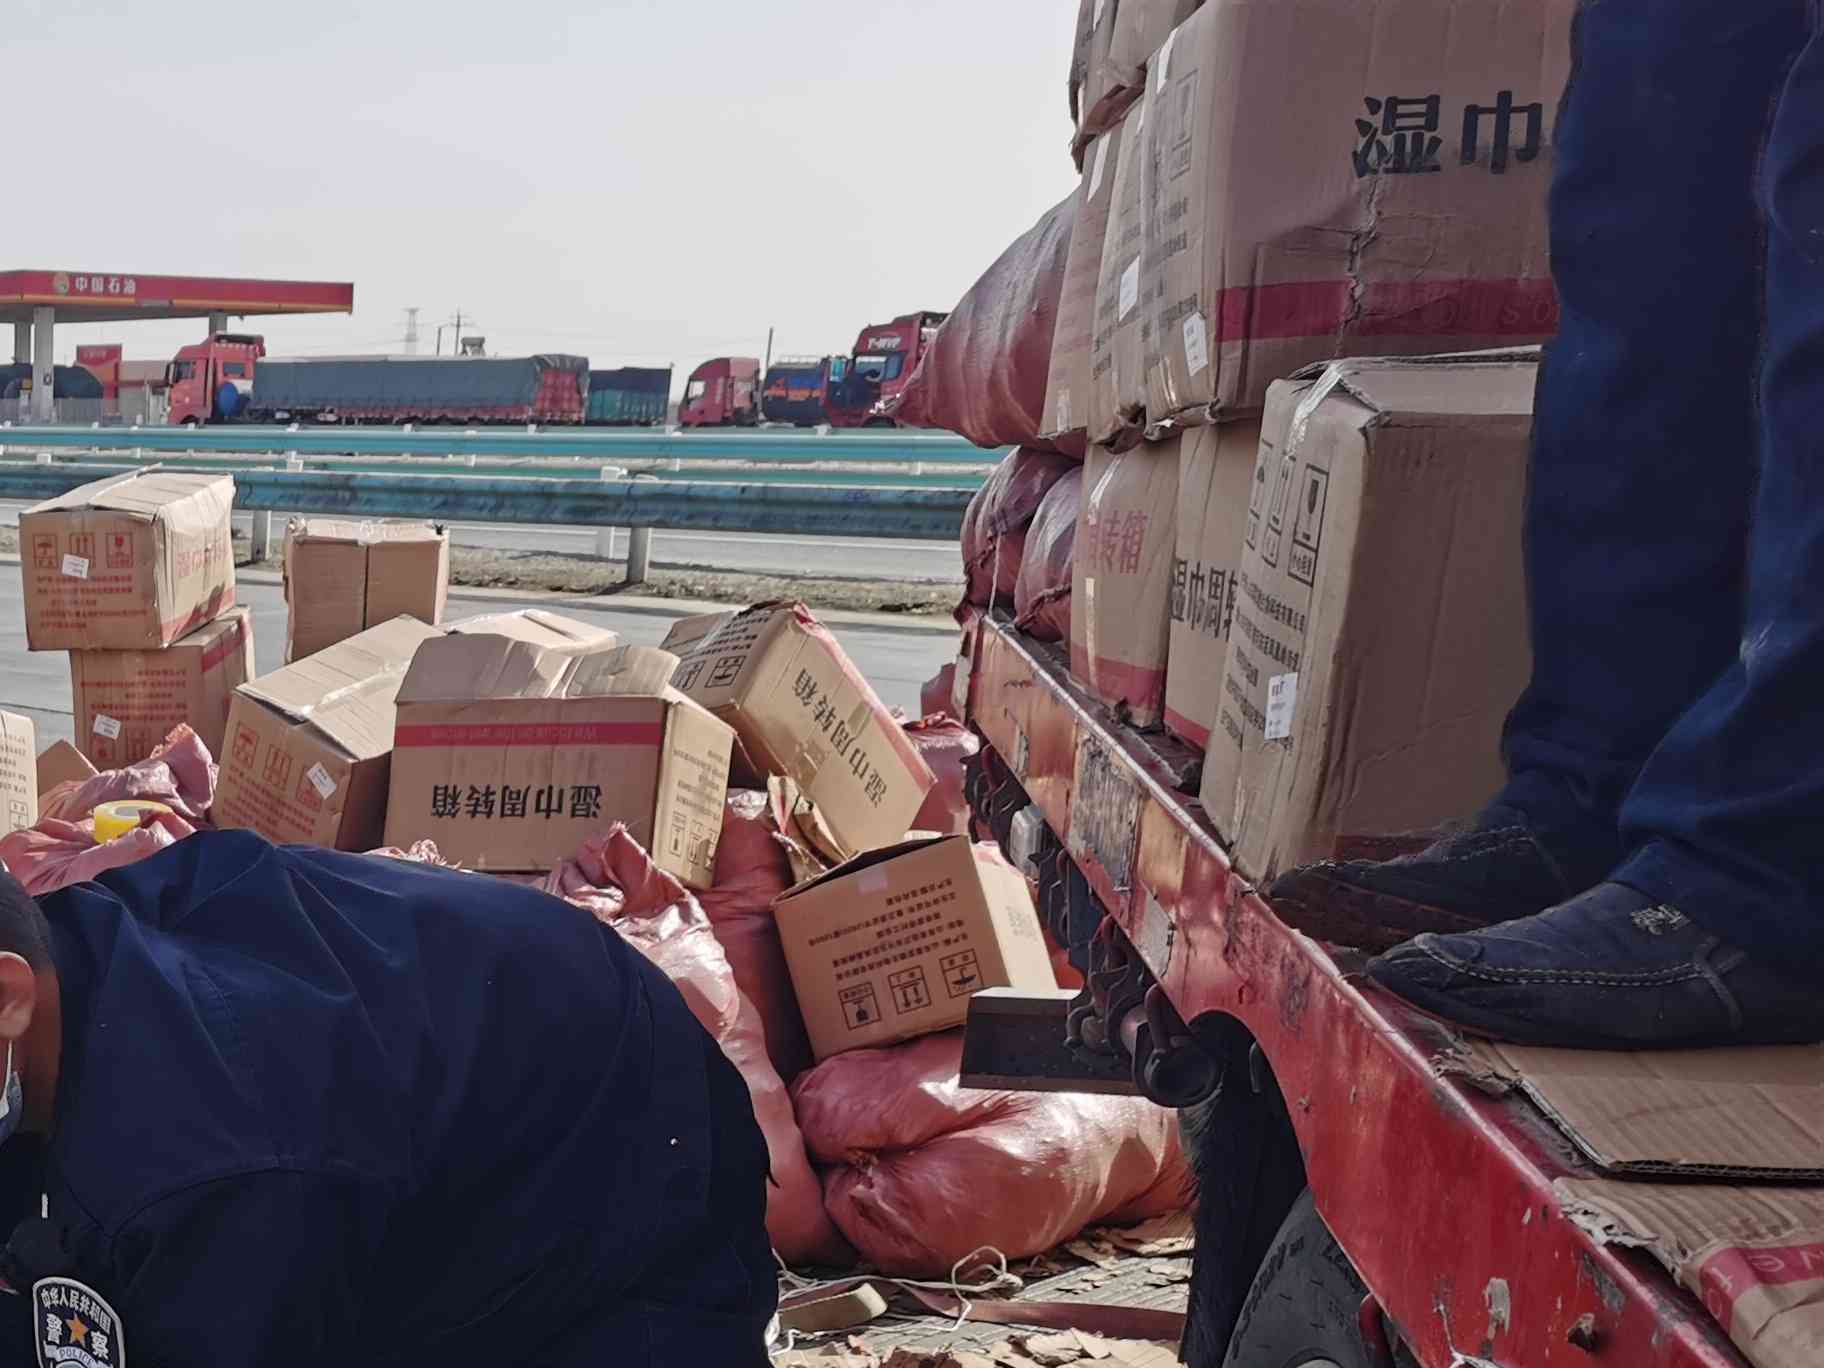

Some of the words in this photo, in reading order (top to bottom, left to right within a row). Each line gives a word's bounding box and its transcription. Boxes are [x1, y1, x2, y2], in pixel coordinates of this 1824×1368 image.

[1351, 90, 1544, 178] 湿巾
[74, 276, 136, 294] 中国石油
[793, 667, 888, 808] 湿巾周转箱
[430, 783, 602, 820] 湿巾周转箱
[40, 1286, 112, 1335] 中华人民共和国
